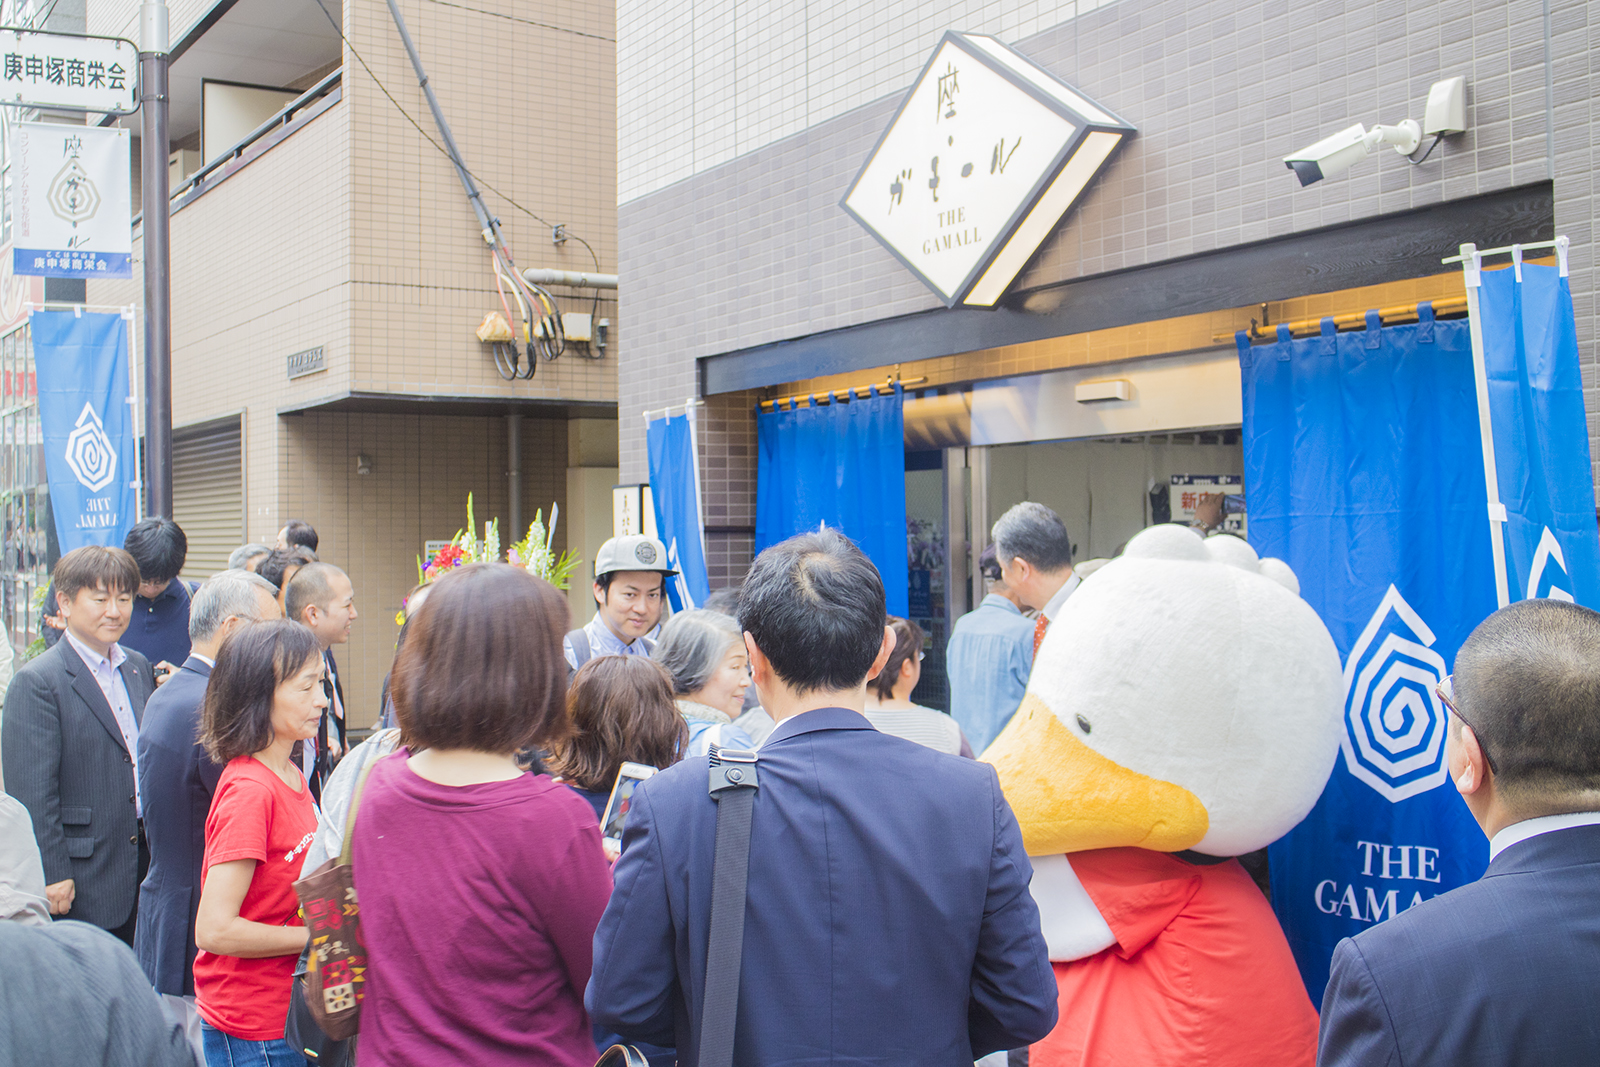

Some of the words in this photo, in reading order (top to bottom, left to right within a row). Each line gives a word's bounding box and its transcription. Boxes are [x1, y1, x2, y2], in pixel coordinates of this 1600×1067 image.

[4, 52, 126, 91] 庚申塚商栄会
[937, 206, 966, 228] THE
[922, 227, 982, 255] GAMALL
[34, 257, 107, 271] 庚申塚商栄会
[1357, 840, 1441, 883] THE
